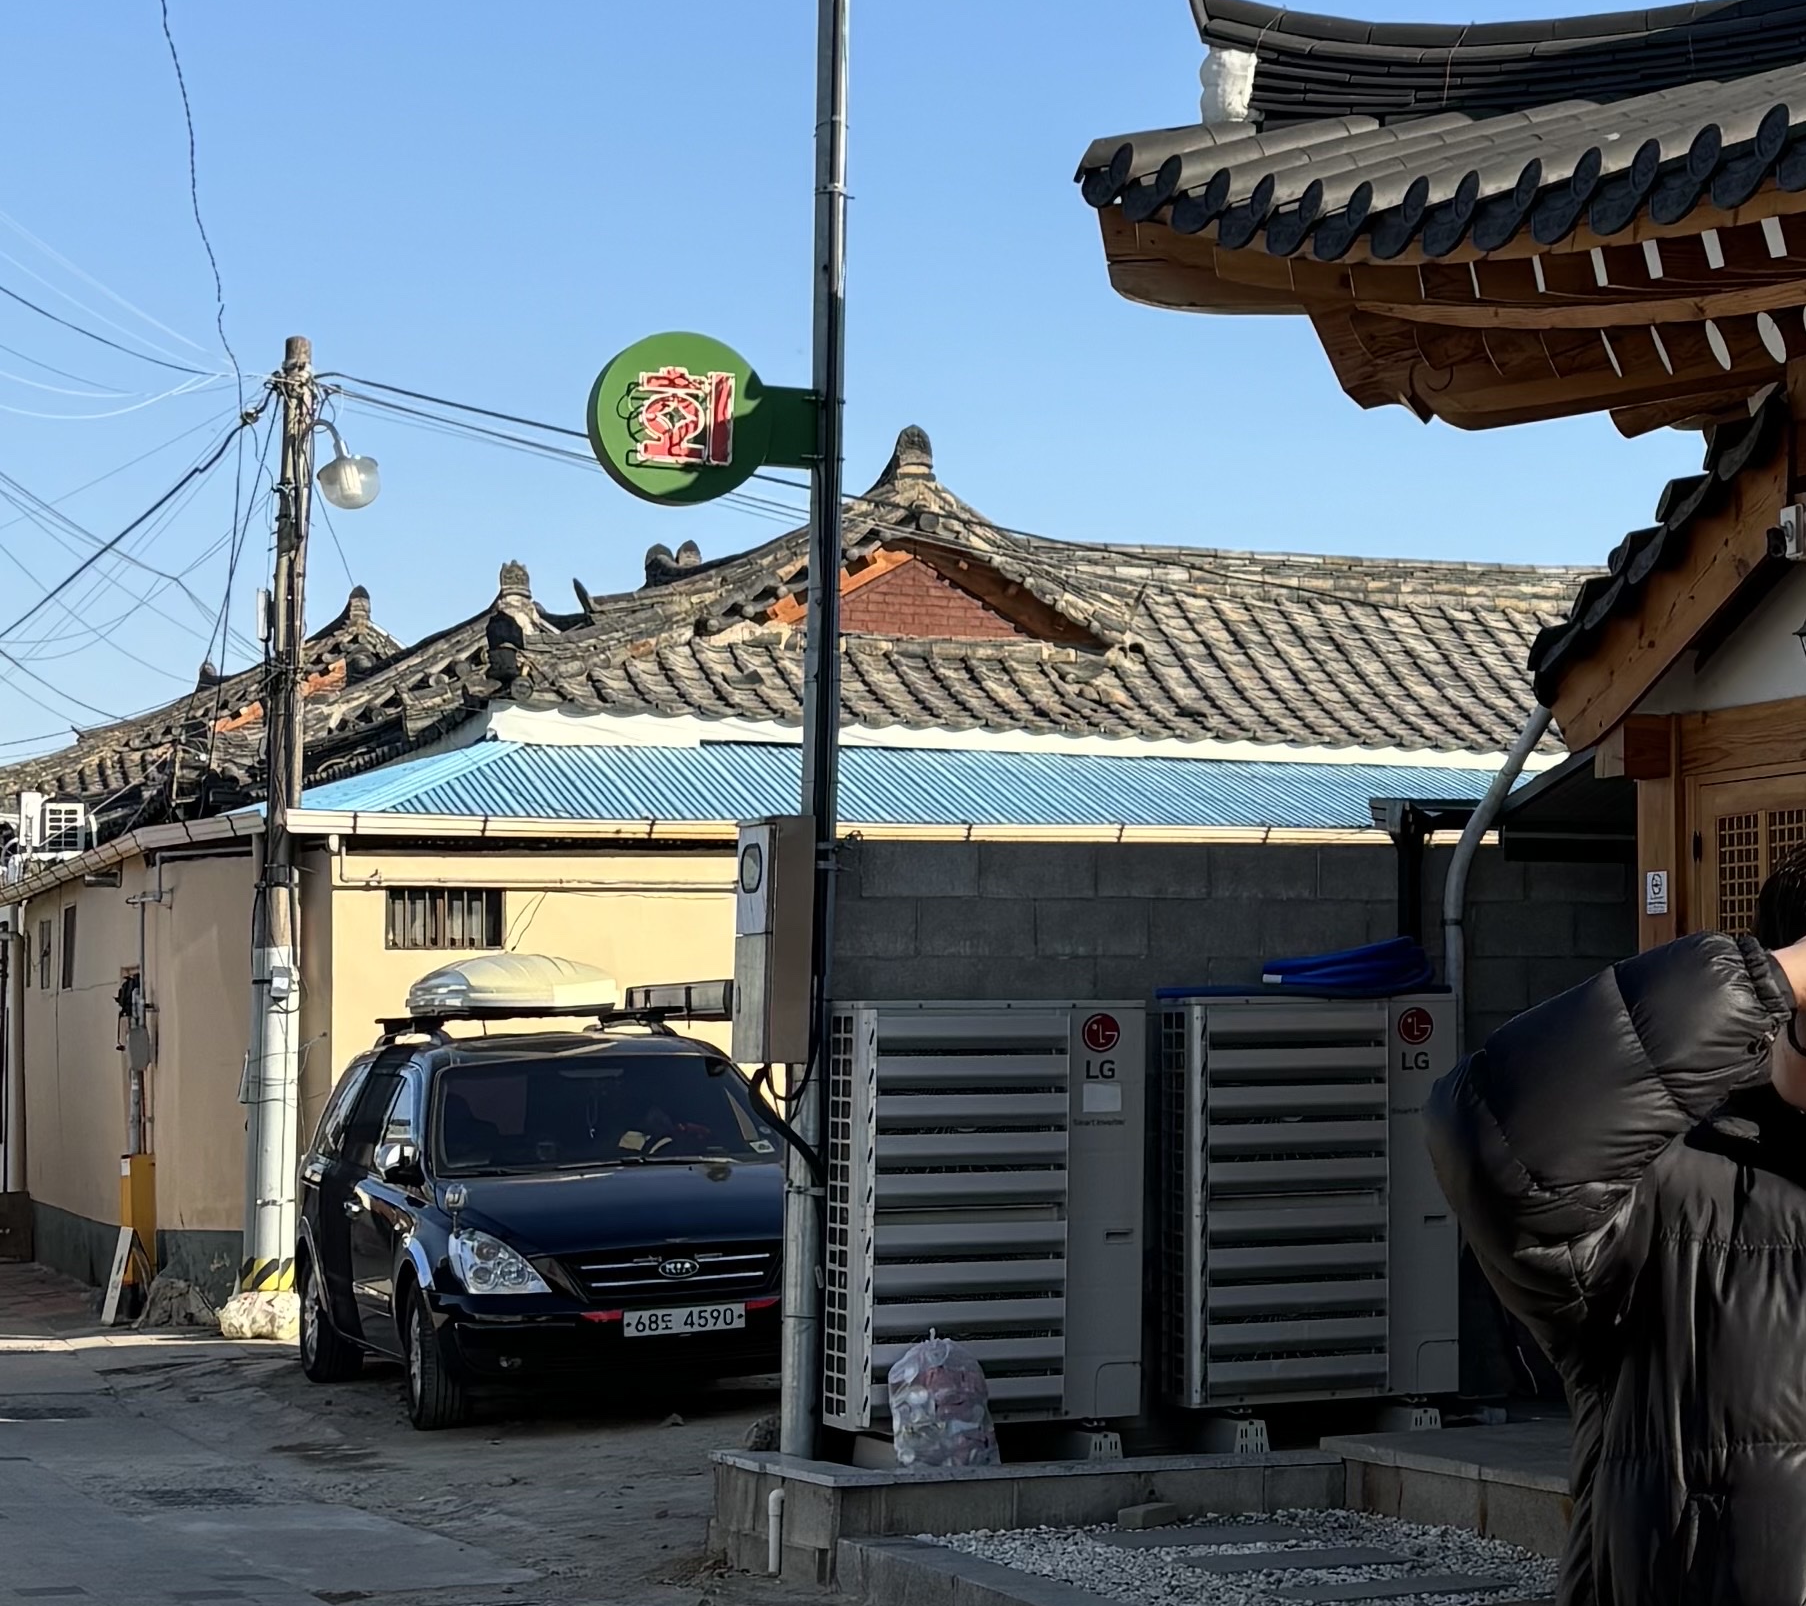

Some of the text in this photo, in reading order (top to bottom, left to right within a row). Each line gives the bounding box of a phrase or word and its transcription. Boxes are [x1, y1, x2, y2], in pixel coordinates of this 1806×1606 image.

[637, 366, 736, 467] 회
[1085, 1059, 1116, 1079] LG
[1401, 1051, 1430, 1071] LG
[666, 1262, 692, 1273] KIA
[635, 1307, 734, 1333] 68도 4590
